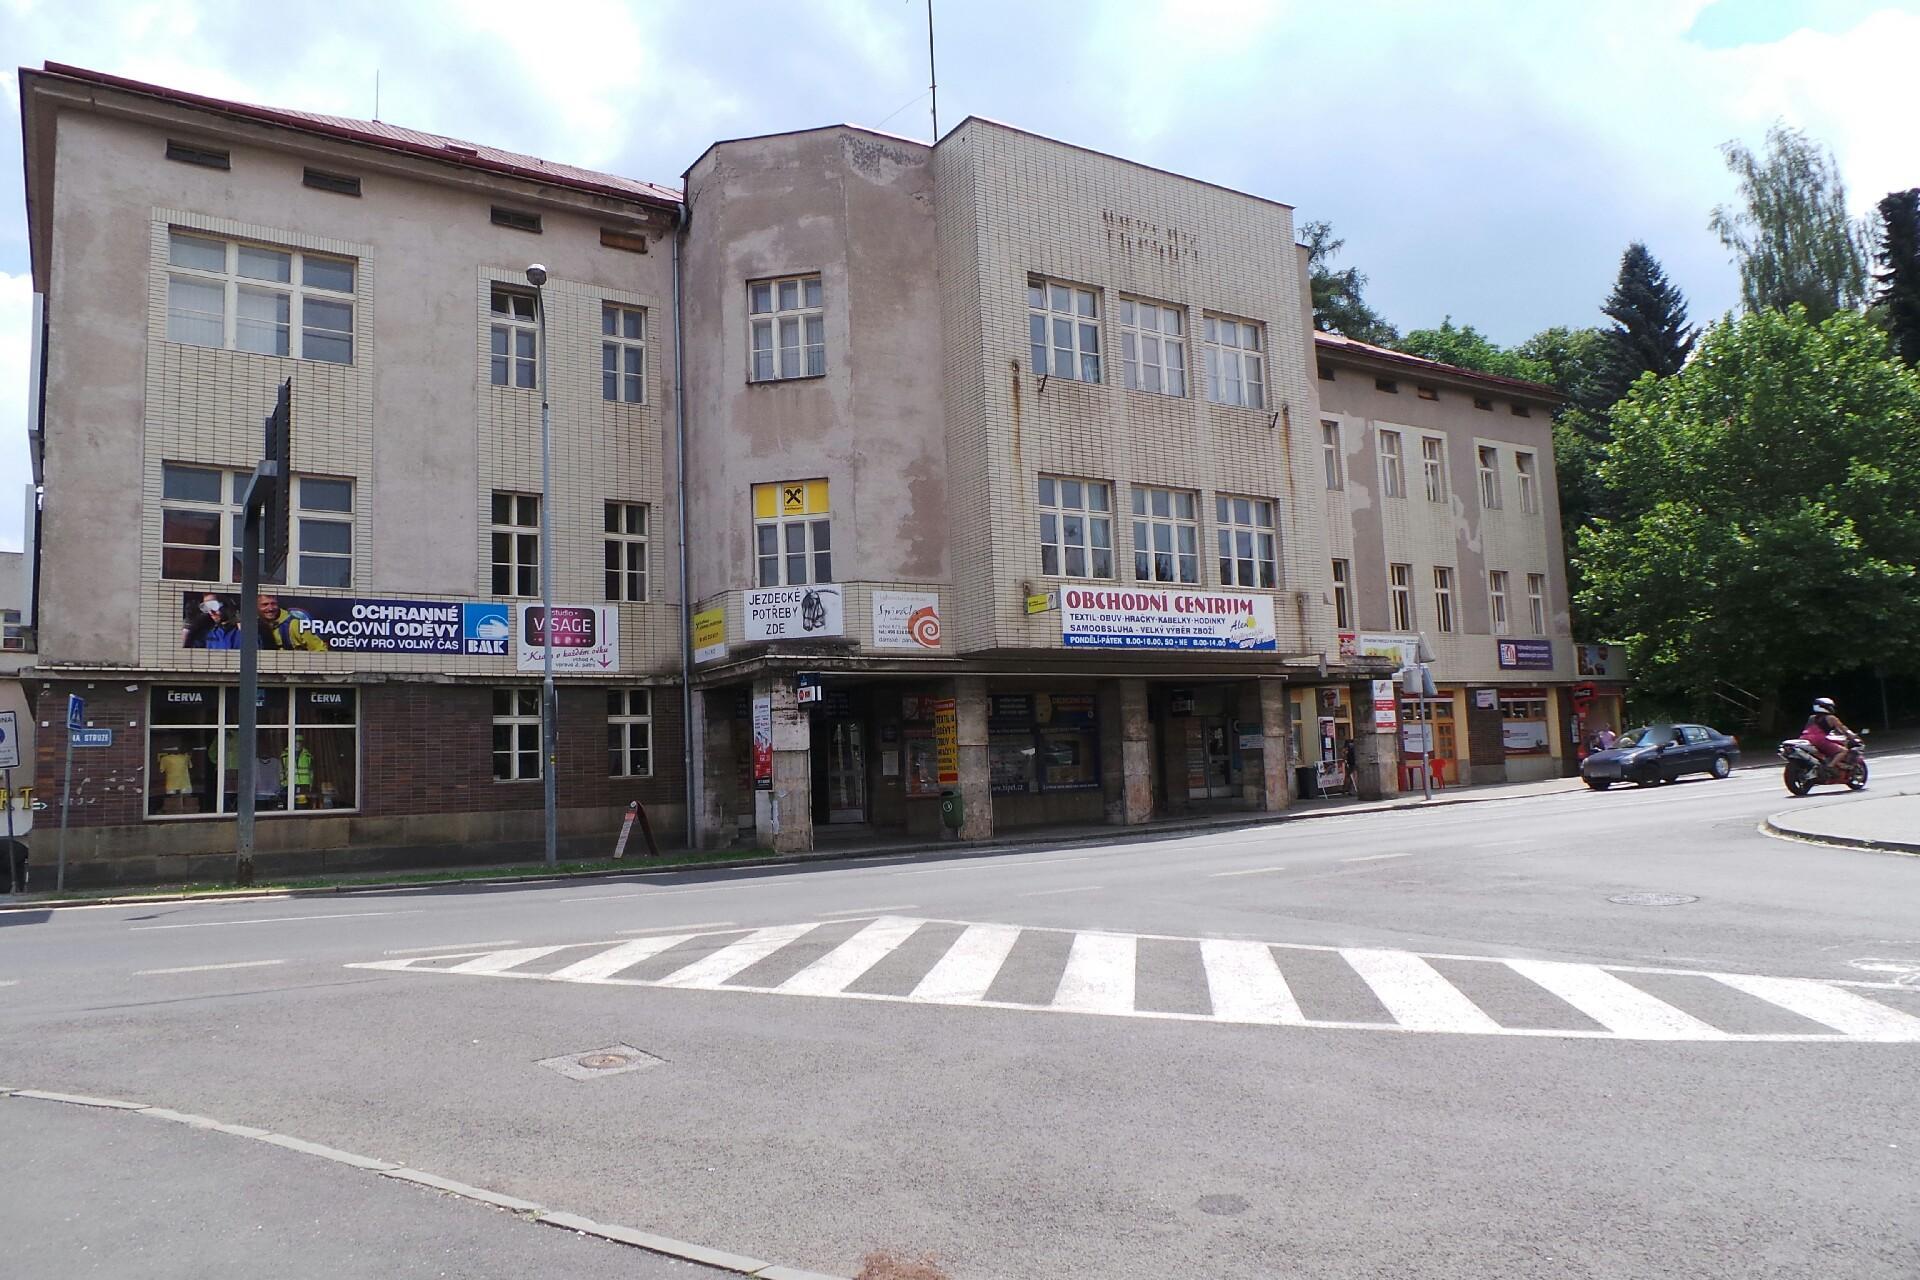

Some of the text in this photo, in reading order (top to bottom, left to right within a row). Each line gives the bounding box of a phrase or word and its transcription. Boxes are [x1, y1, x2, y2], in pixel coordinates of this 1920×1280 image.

[749, 588, 800, 605] JEZDECKÉ
[1066, 590, 1254, 615] OBCHODNÍ CENTRUM
[352, 605, 459, 622] OCHRANNÉ
[752, 605, 798, 620] POTŘEBY
[1070, 613, 1225, 625] TEXTIL OBUV HRAČKY KABELKY HODINKY
[300, 619, 459, 637] PRACOVNÍ ODĚVY
[533, 617, 592, 633] VSAGE
[766, 623, 785, 635] ZDE
[1070, 625, 1215, 635] SAMOOBSLUHA VELKÝ VÝBĚR ZBOŽÍ
[330, 636, 459, 650] ODĚVY PRO VOLNÝ ČAS
[468, 640, 505, 653] BMK
[168, 690, 202, 701] ČERVA
[311, 692, 341, 702] ČERVA
